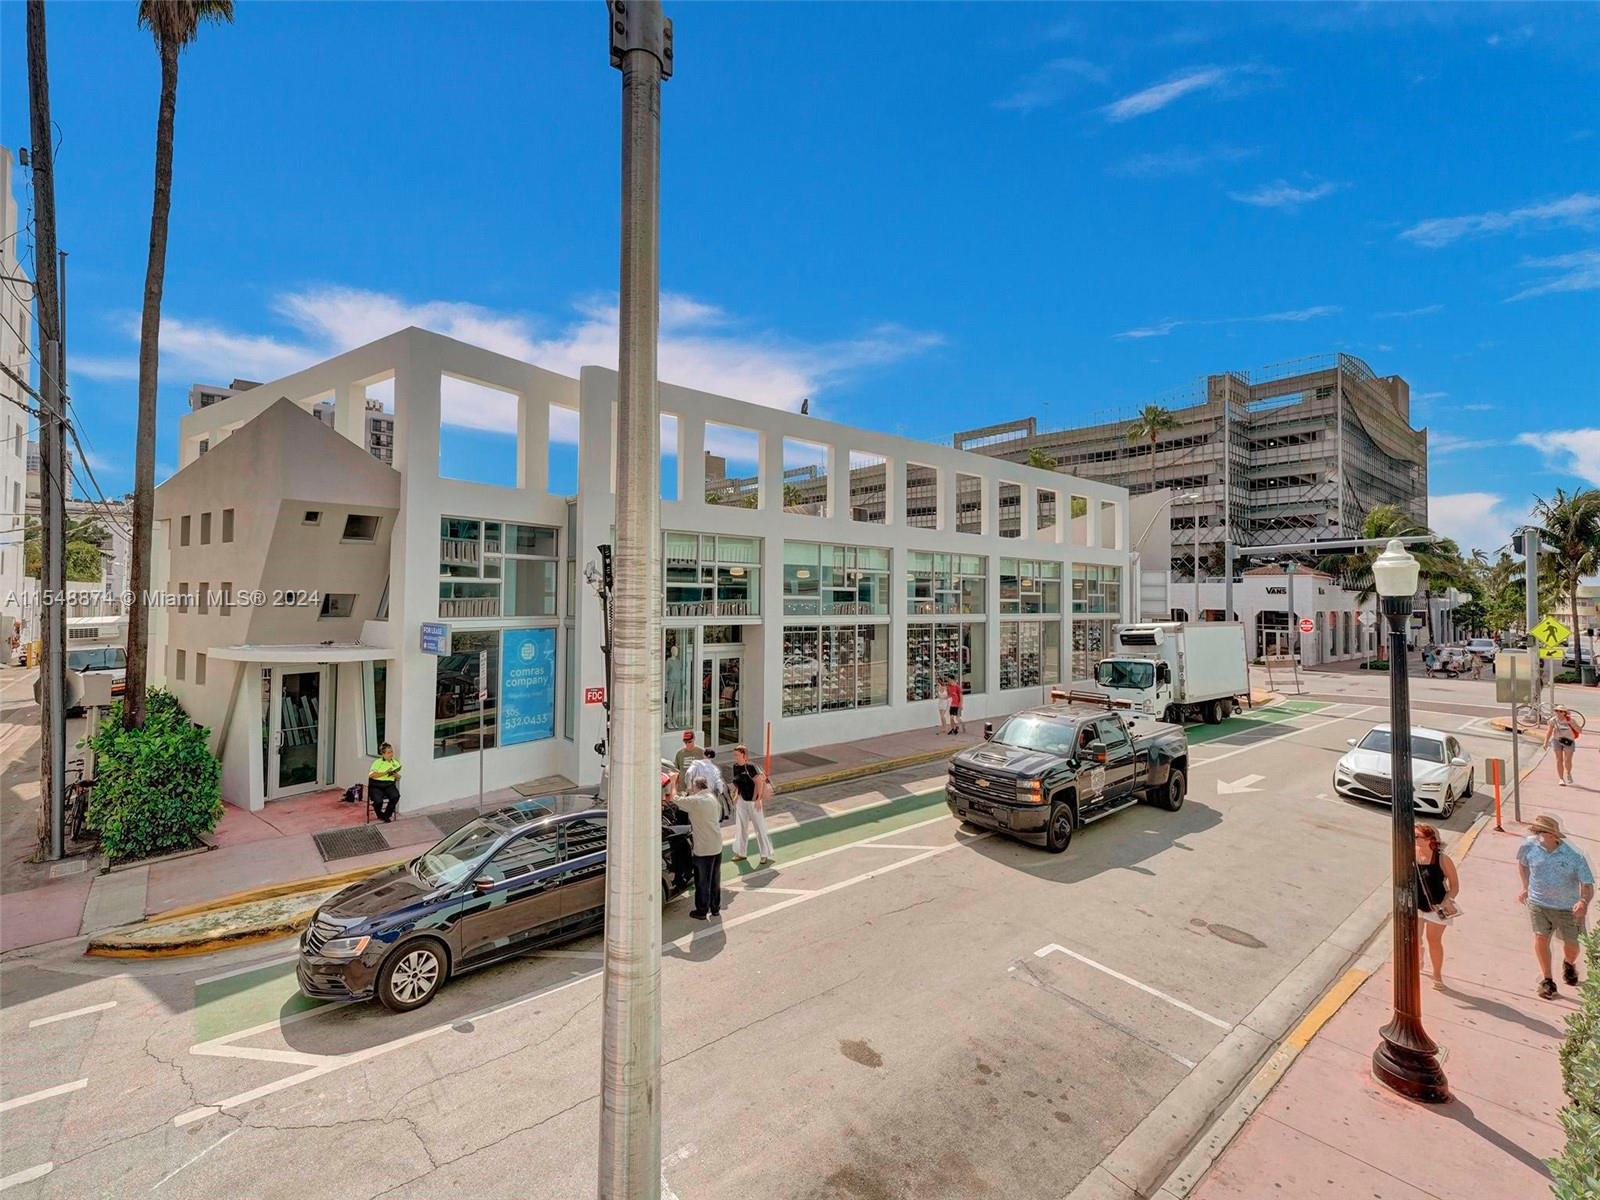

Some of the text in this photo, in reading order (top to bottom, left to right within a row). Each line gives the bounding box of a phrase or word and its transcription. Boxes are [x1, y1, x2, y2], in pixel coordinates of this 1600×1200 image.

[510, 667, 544, 678] comras
[505, 675, 548, 688] company
[587, 691, 603, 701] FDC
